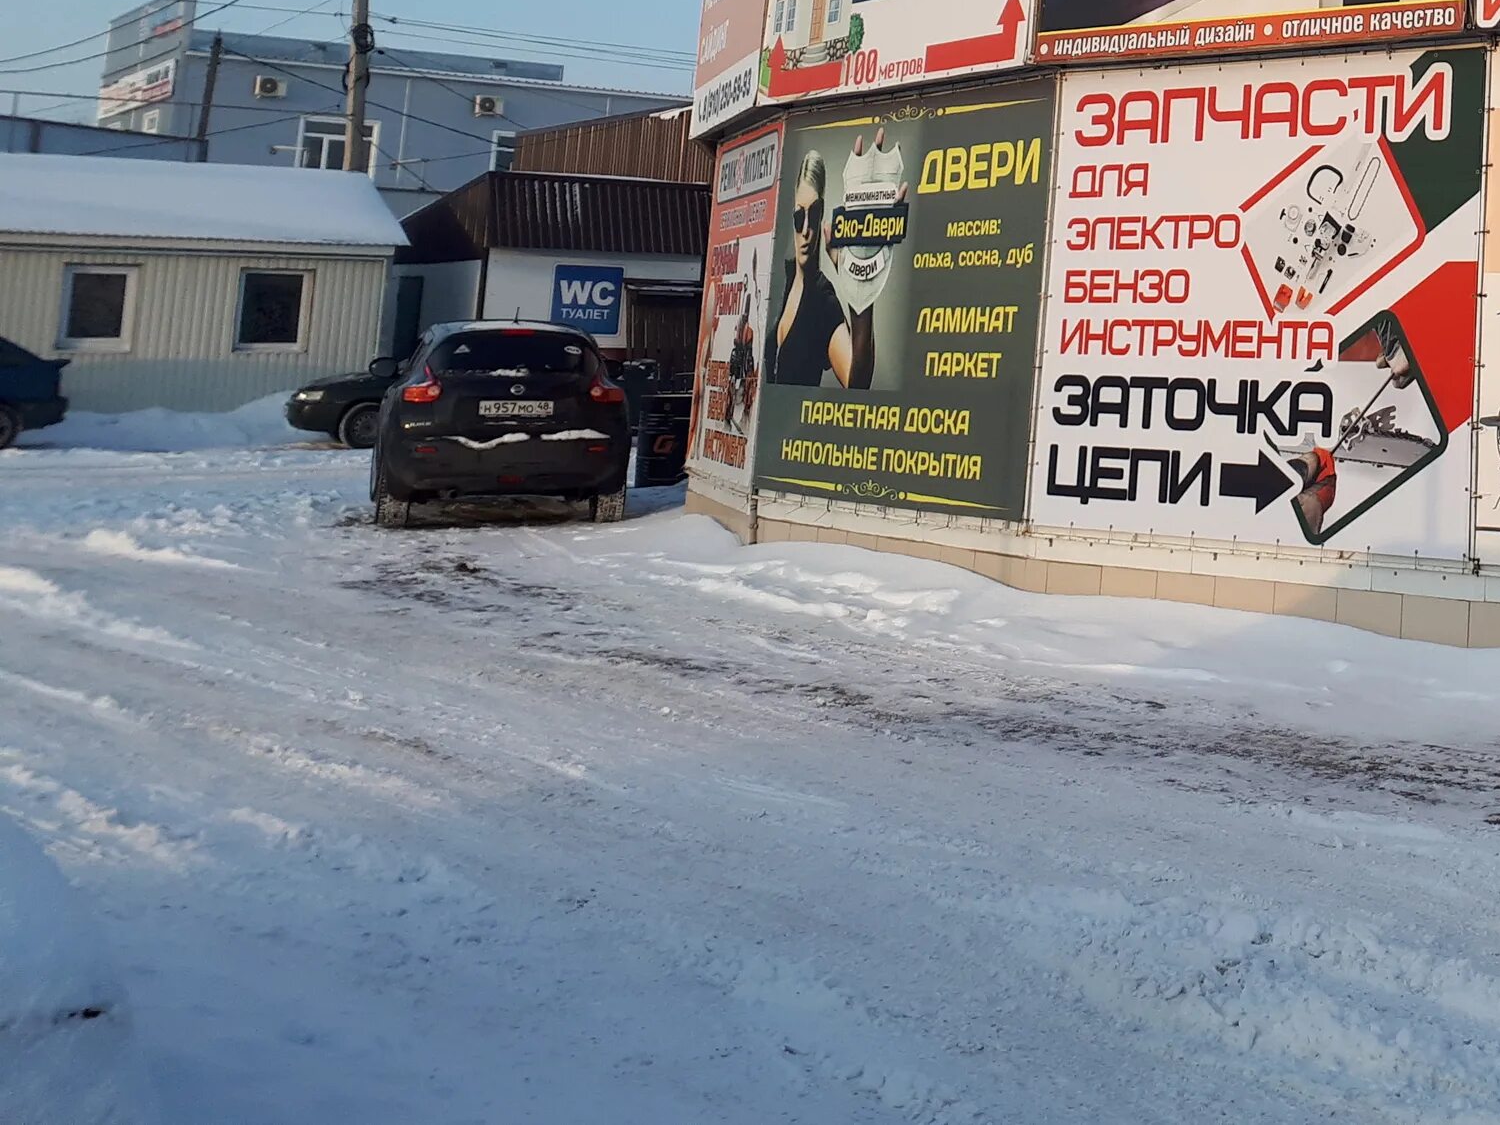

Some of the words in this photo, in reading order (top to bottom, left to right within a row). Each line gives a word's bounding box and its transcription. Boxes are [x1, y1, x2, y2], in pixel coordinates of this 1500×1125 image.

[1053, 29, 1190, 57] индивидуальный
[1194, 21, 1255, 48] дизайн
[1281, 13, 1364, 39] отличное
[1369, 5, 1456, 33] качество
[844, 49, 879, 86] 100
[879, 56, 924, 85] метров
[1073, 70, 1447, 148] ЗАПЧАСТИ
[916, 137, 1042, 195] ДВЕРИ
[1068, 162, 1150, 199] ДЛЯ
[834, 213, 904, 241] Эко-Двери
[947, 217, 1001, 238] массив:
[1065, 213, 1241, 251] ЭЛЕКТРО
[849, 260, 878, 281] двери
[913, 251, 954, 270] ольха,
[958, 249, 1002, 269] сосна,
[1006, 242, 1034, 268] дуб
[560, 280, 615, 306] WC
[1062, 268, 1190, 304] БЕНЗО
[561, 308, 610, 320] ТУАЛЕТ
[916, 305, 1018, 334] ЛАМИНАТ
[1059, 317, 1334, 361] ИНСТРУМЕНТА
[925, 351, 1002, 379] ПАРКЕТ
[800, 399, 900, 431] ПАРКЕТНАЯ
[903, 406, 970, 436] ДОСКА
[1051, 373, 1335, 438] ЗАТОЧКА
[781, 439, 878, 471] НАПОЛЬНЫЕ
[882, 450, 982, 481] ПОКРЫТИЯ
[1046, 443, 1213, 507] ЦЕПИ
